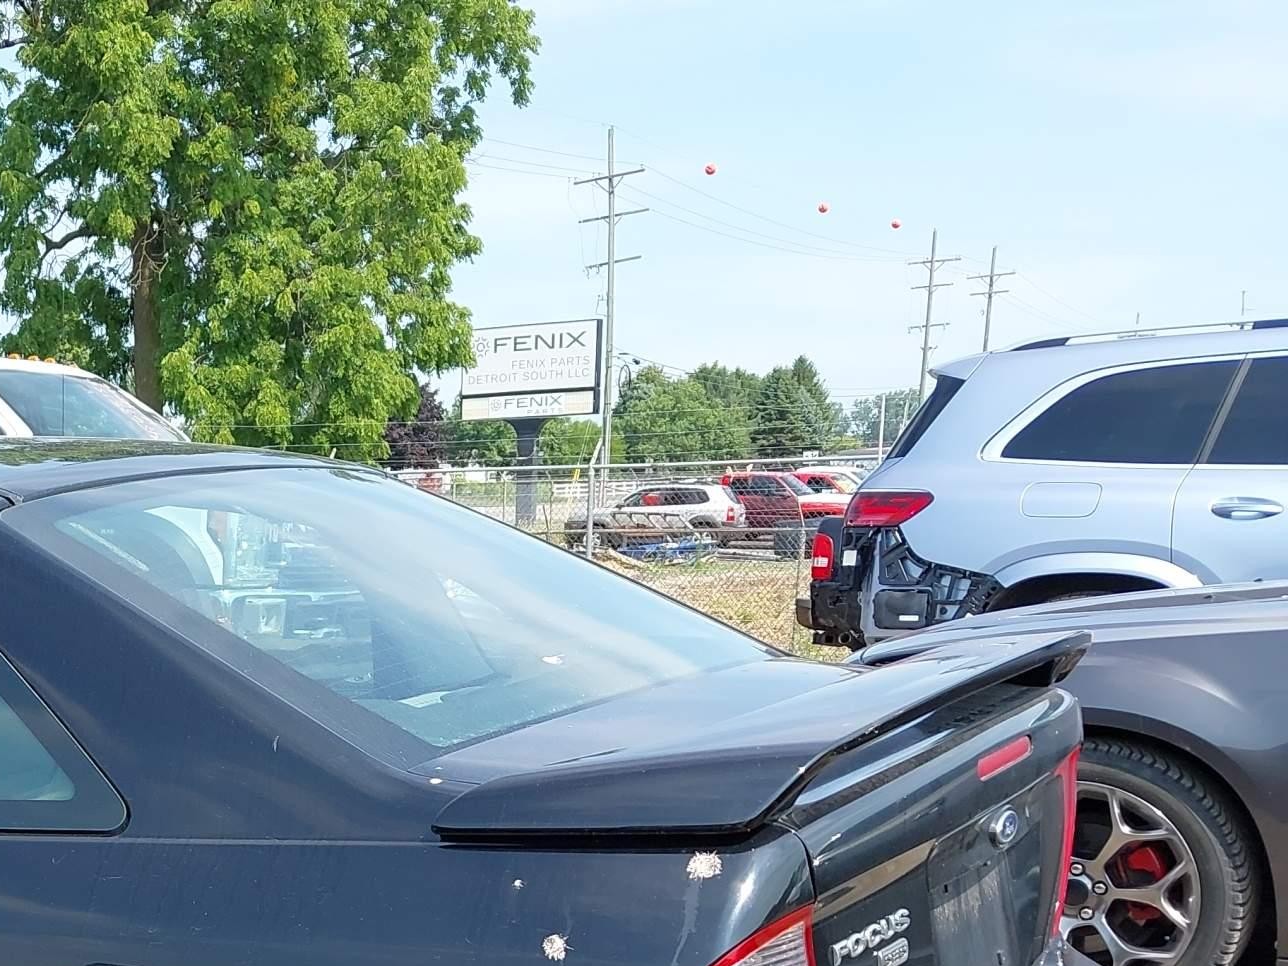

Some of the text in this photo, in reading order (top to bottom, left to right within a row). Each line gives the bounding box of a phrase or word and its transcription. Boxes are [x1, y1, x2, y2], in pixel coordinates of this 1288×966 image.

[494, 331, 587, 353] FENIX
[512, 355, 590, 371] FENIX PARTS
[468, 367, 590, 385] DETROIT SOUTH LLC
[504, 395, 562, 409] FENIX
[829, 908, 911, 966] FOCUS
